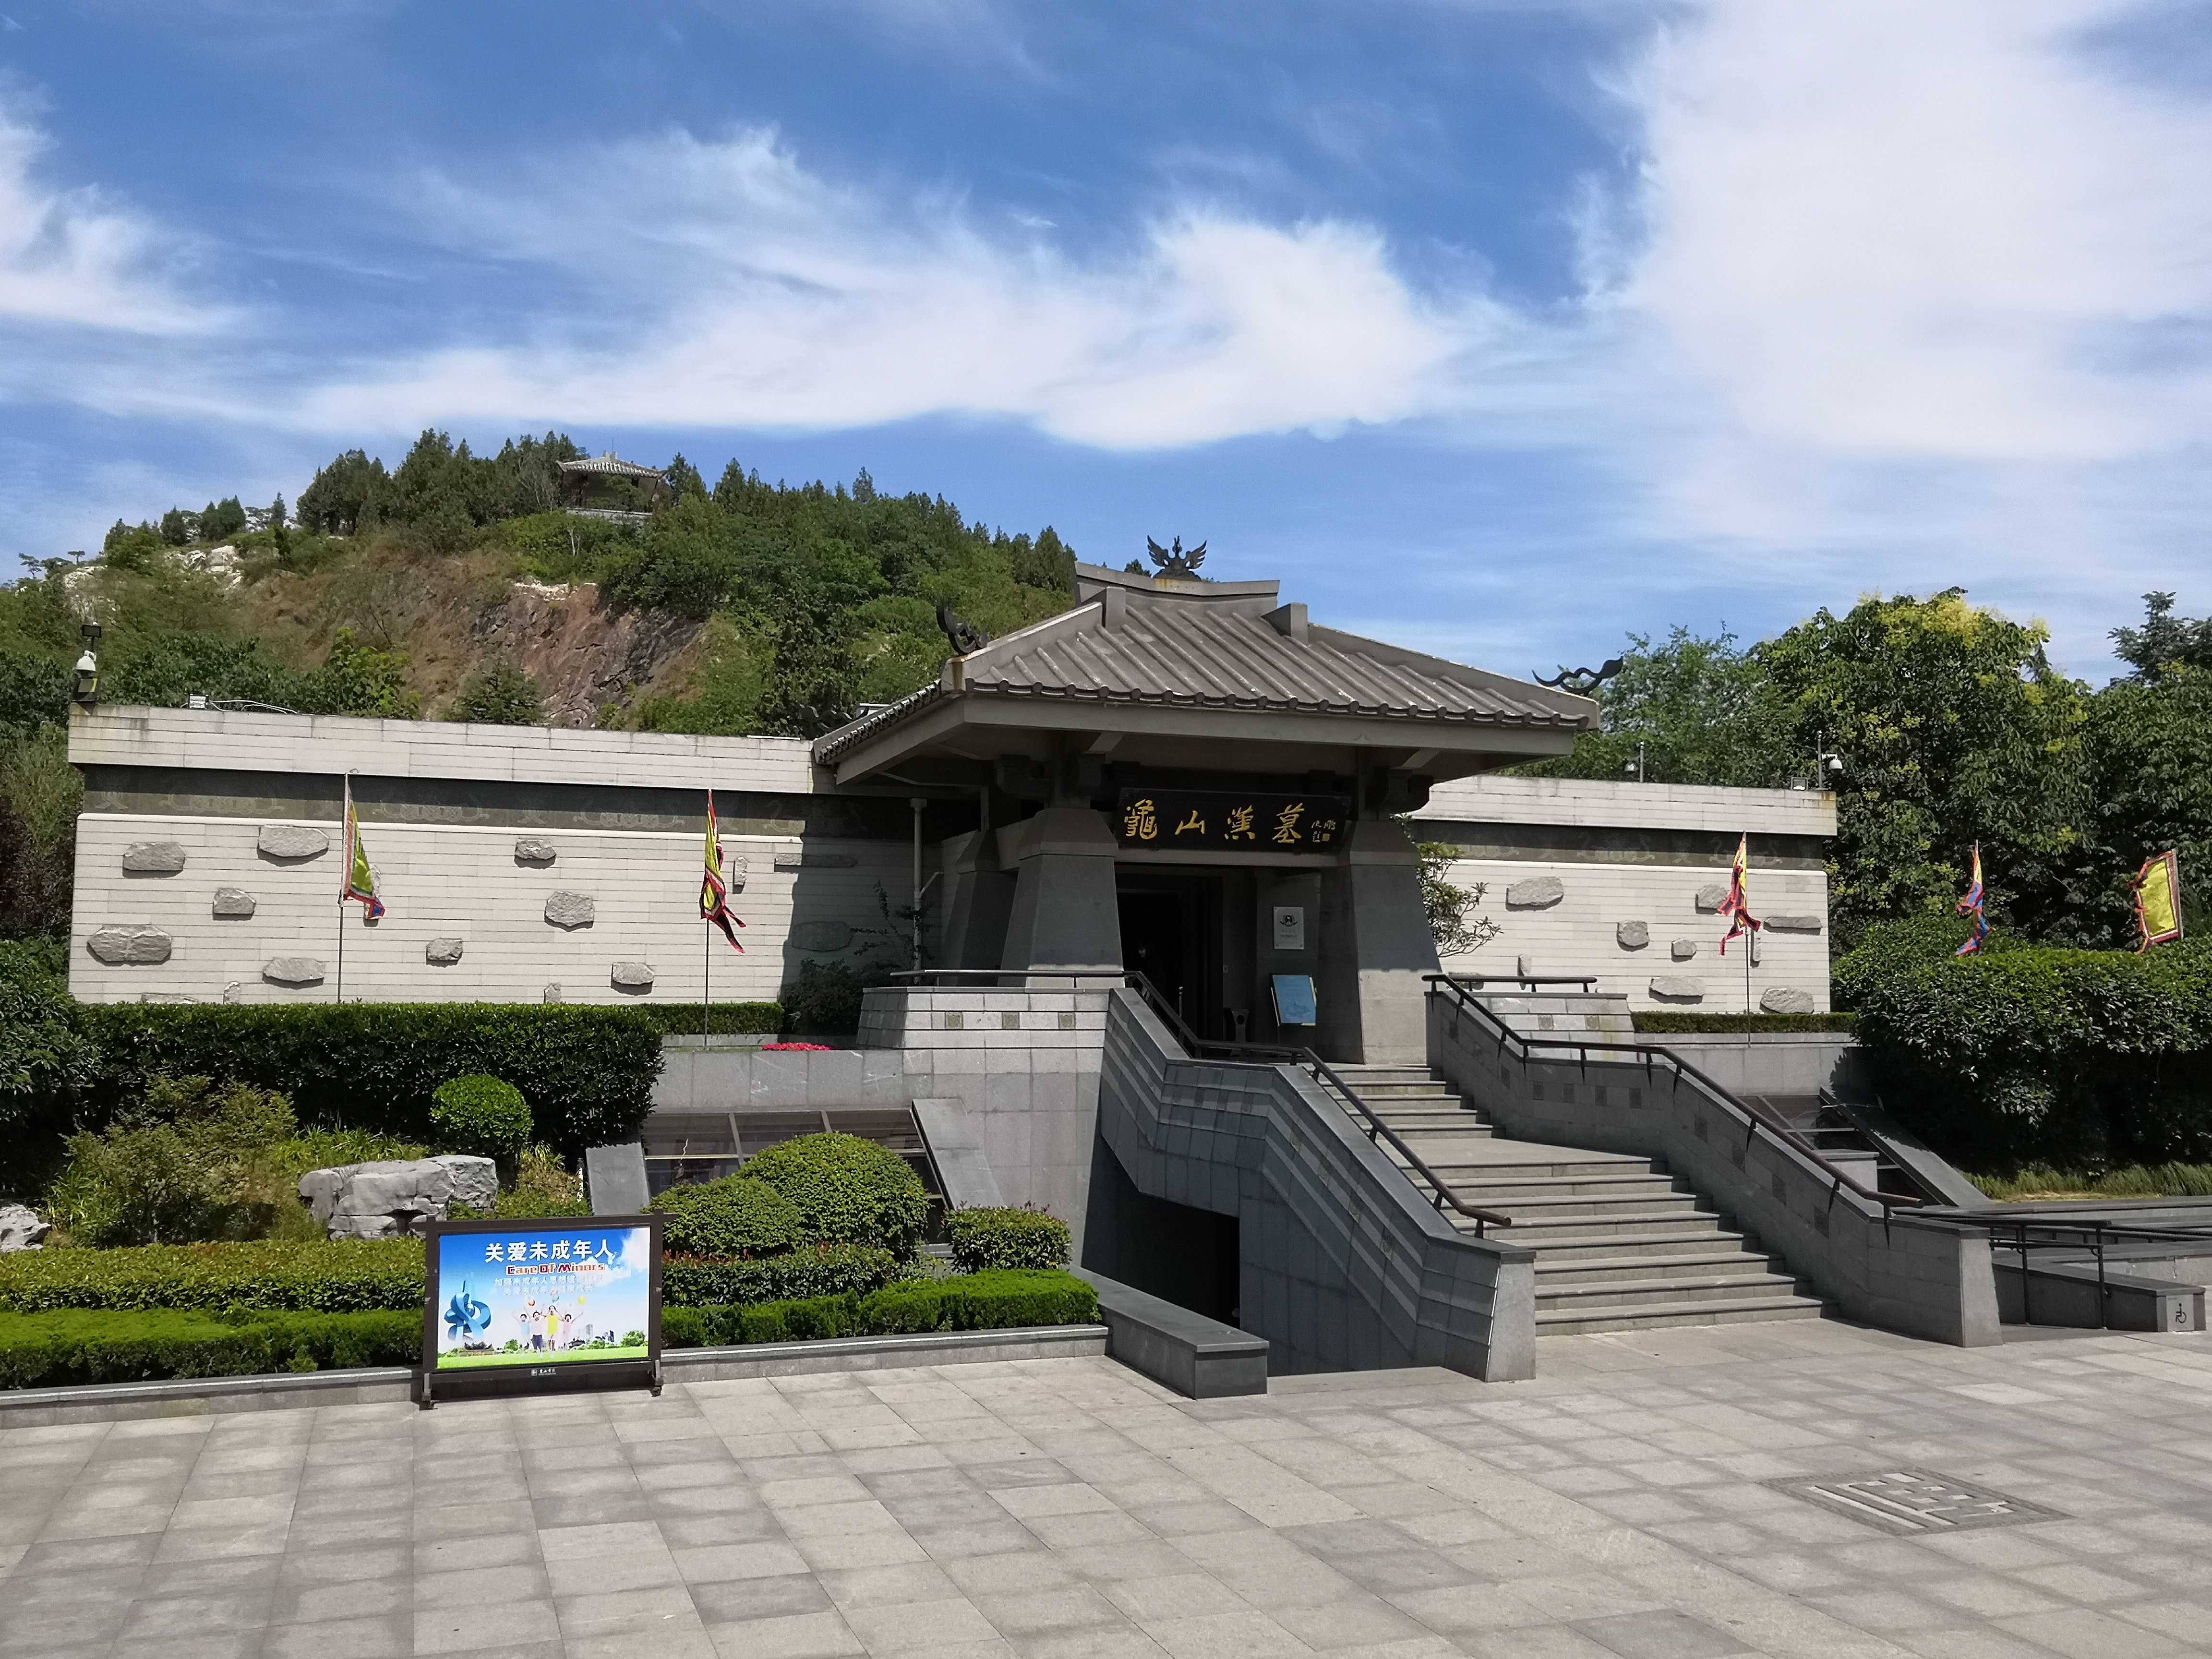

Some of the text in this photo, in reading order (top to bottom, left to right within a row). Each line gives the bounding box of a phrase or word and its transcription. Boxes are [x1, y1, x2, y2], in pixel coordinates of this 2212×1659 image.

[484, 1239, 614, 1263] 关爱未成年人
[506, 1262, 605, 1275] Care Of Minors
